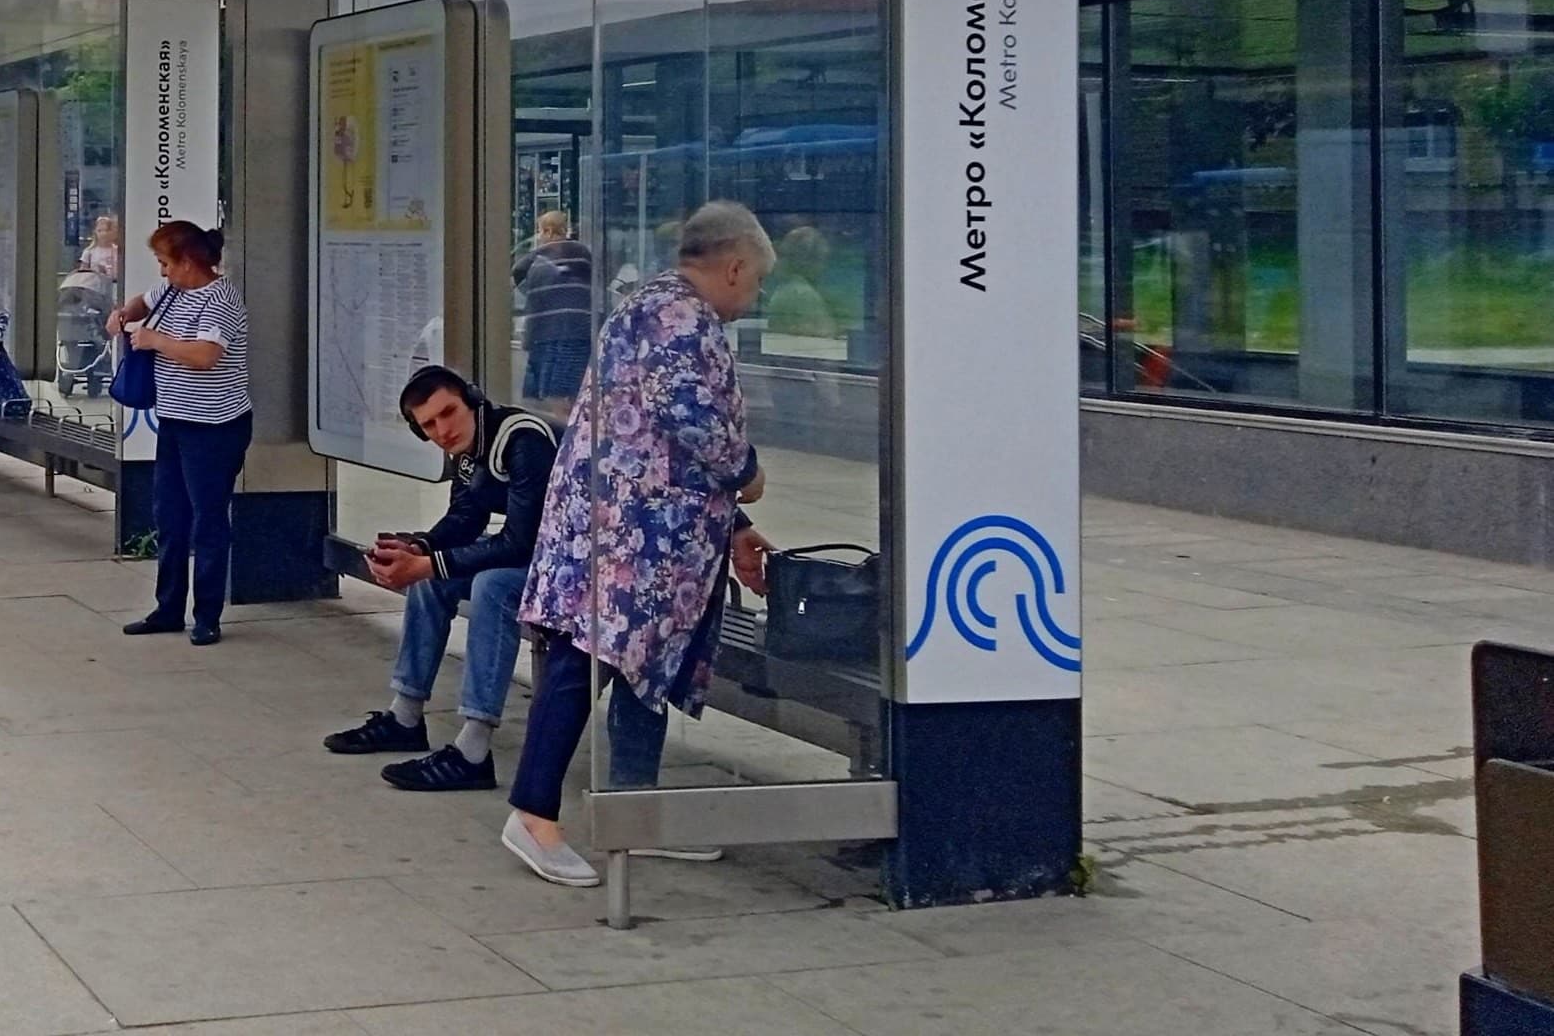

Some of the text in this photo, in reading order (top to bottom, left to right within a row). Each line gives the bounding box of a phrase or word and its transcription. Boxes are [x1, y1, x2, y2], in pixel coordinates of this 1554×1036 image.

[154, 40, 172, 229] тро «Коломенская»
[175, 40, 189, 170] Metro Kolomenskaya
[997, 34, 1018, 110] Metro
[959, 160, 992, 292] Метро
[460, 458, 476, 475] 84
